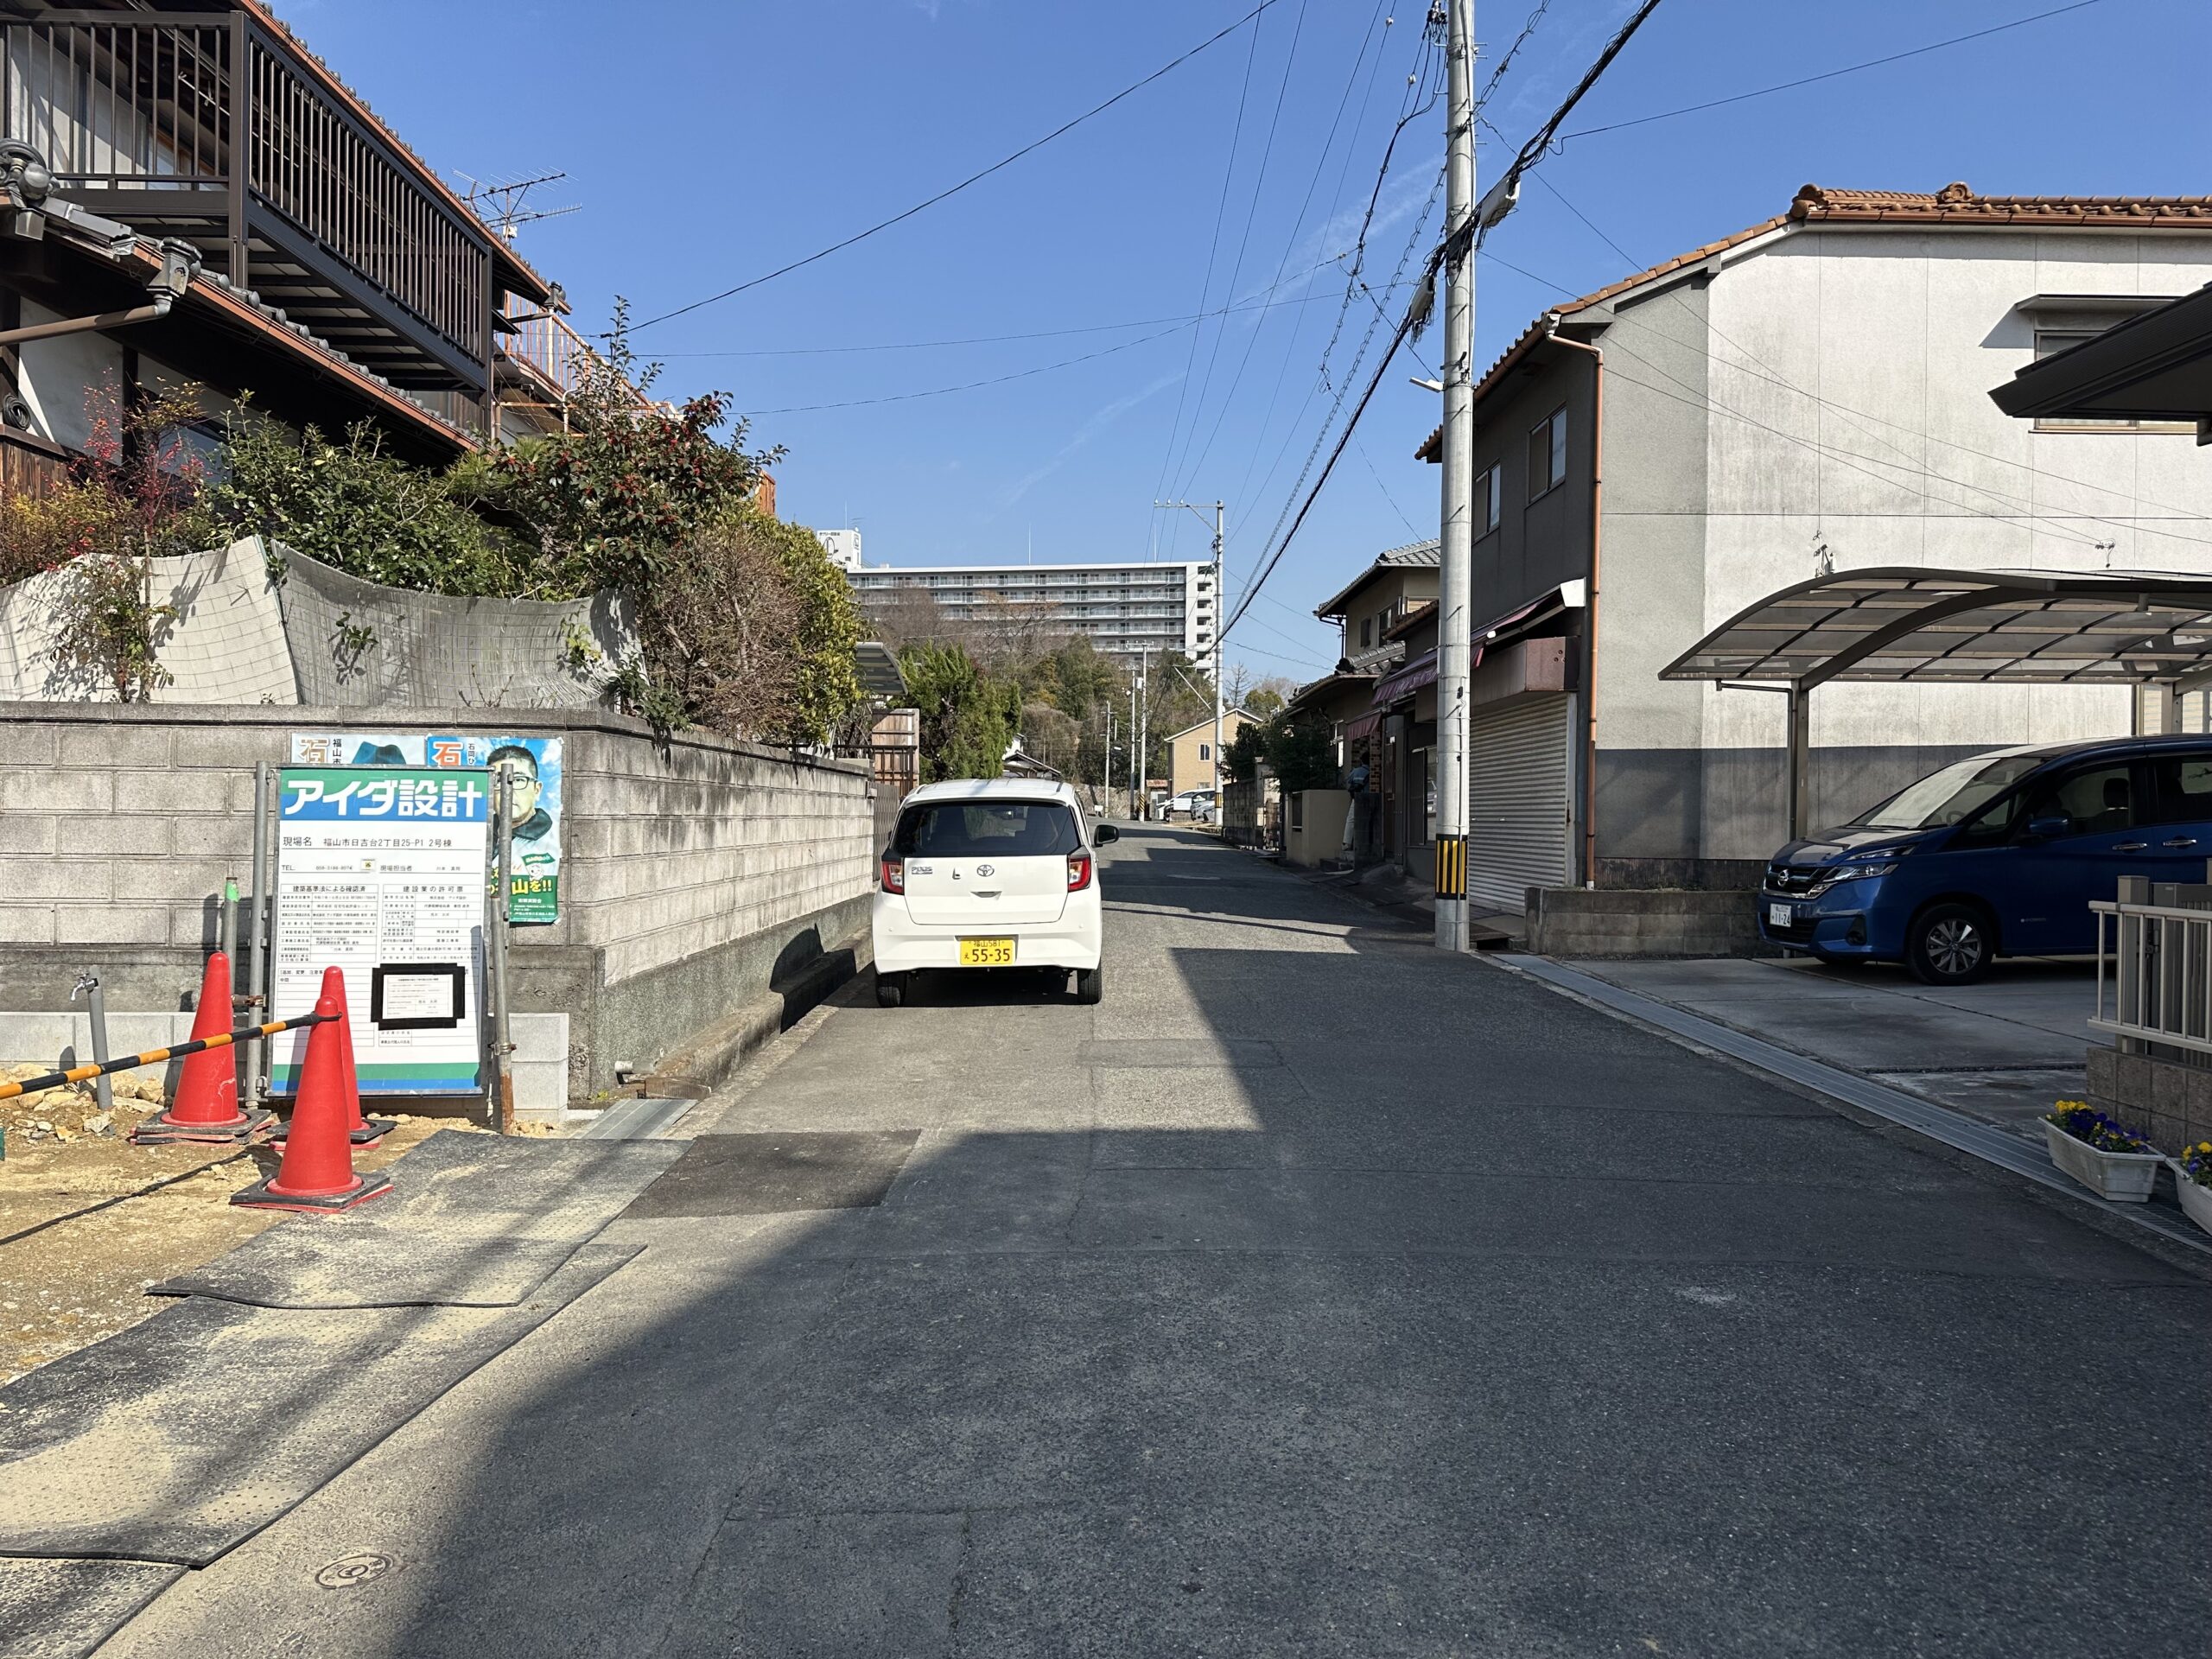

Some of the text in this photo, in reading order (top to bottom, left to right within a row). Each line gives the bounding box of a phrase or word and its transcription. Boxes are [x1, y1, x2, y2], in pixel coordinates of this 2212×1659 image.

[333, 738, 342, 764] 福山市
[434, 742, 462, 766] 石
[284, 779, 482, 817] アイダ設計
[283, 836, 312, 847] 現場名
[972, 949, 1010, 962] 55-35
